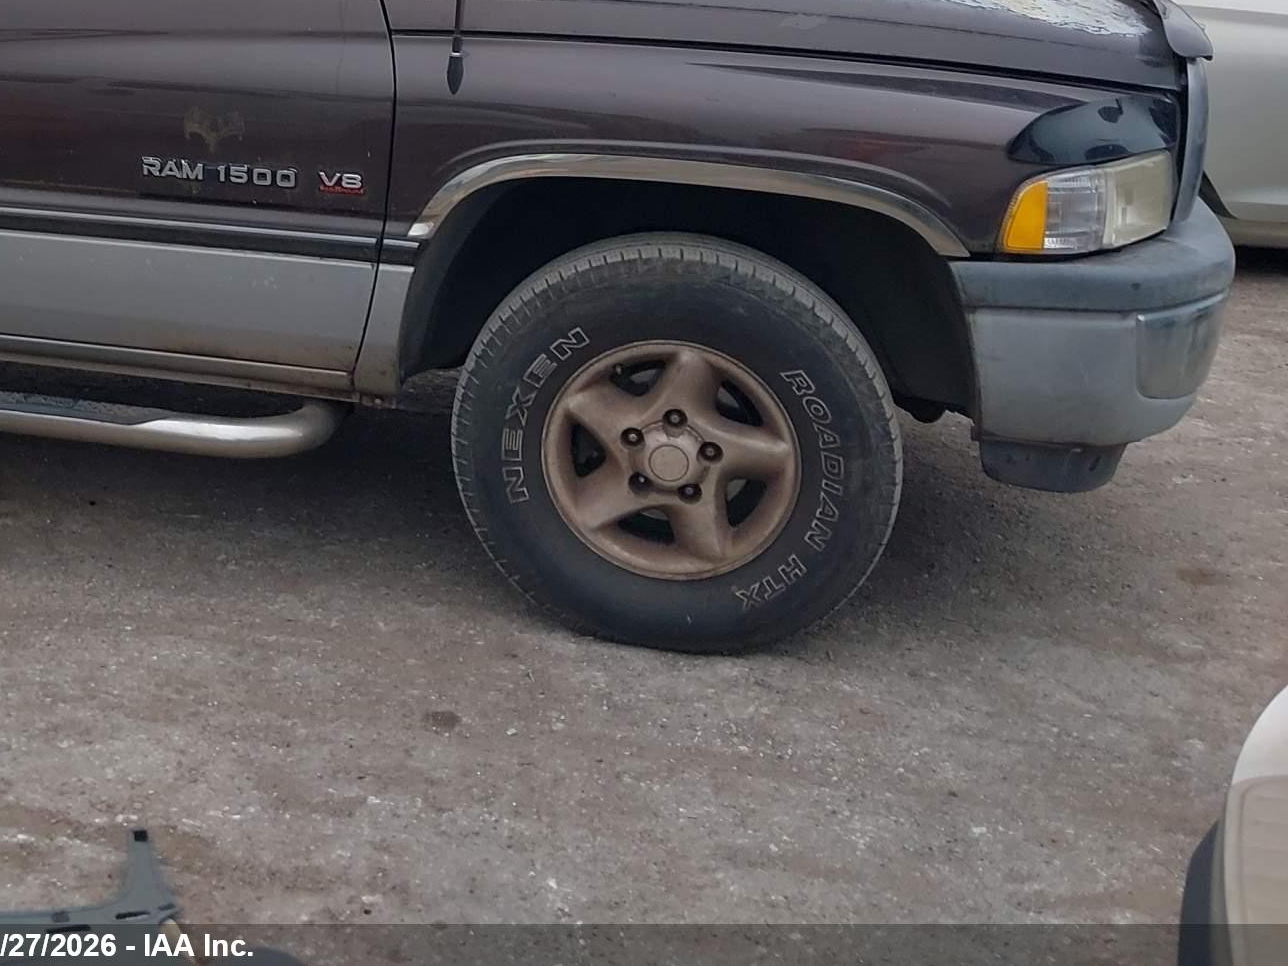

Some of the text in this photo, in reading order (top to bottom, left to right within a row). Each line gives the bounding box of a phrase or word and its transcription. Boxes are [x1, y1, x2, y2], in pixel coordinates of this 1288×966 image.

[141, 155, 363, 189] RAM 1500 V8
[502, 327, 590, 503] NEXEN
[734, 369, 844, 611] ROADIAN HTX
